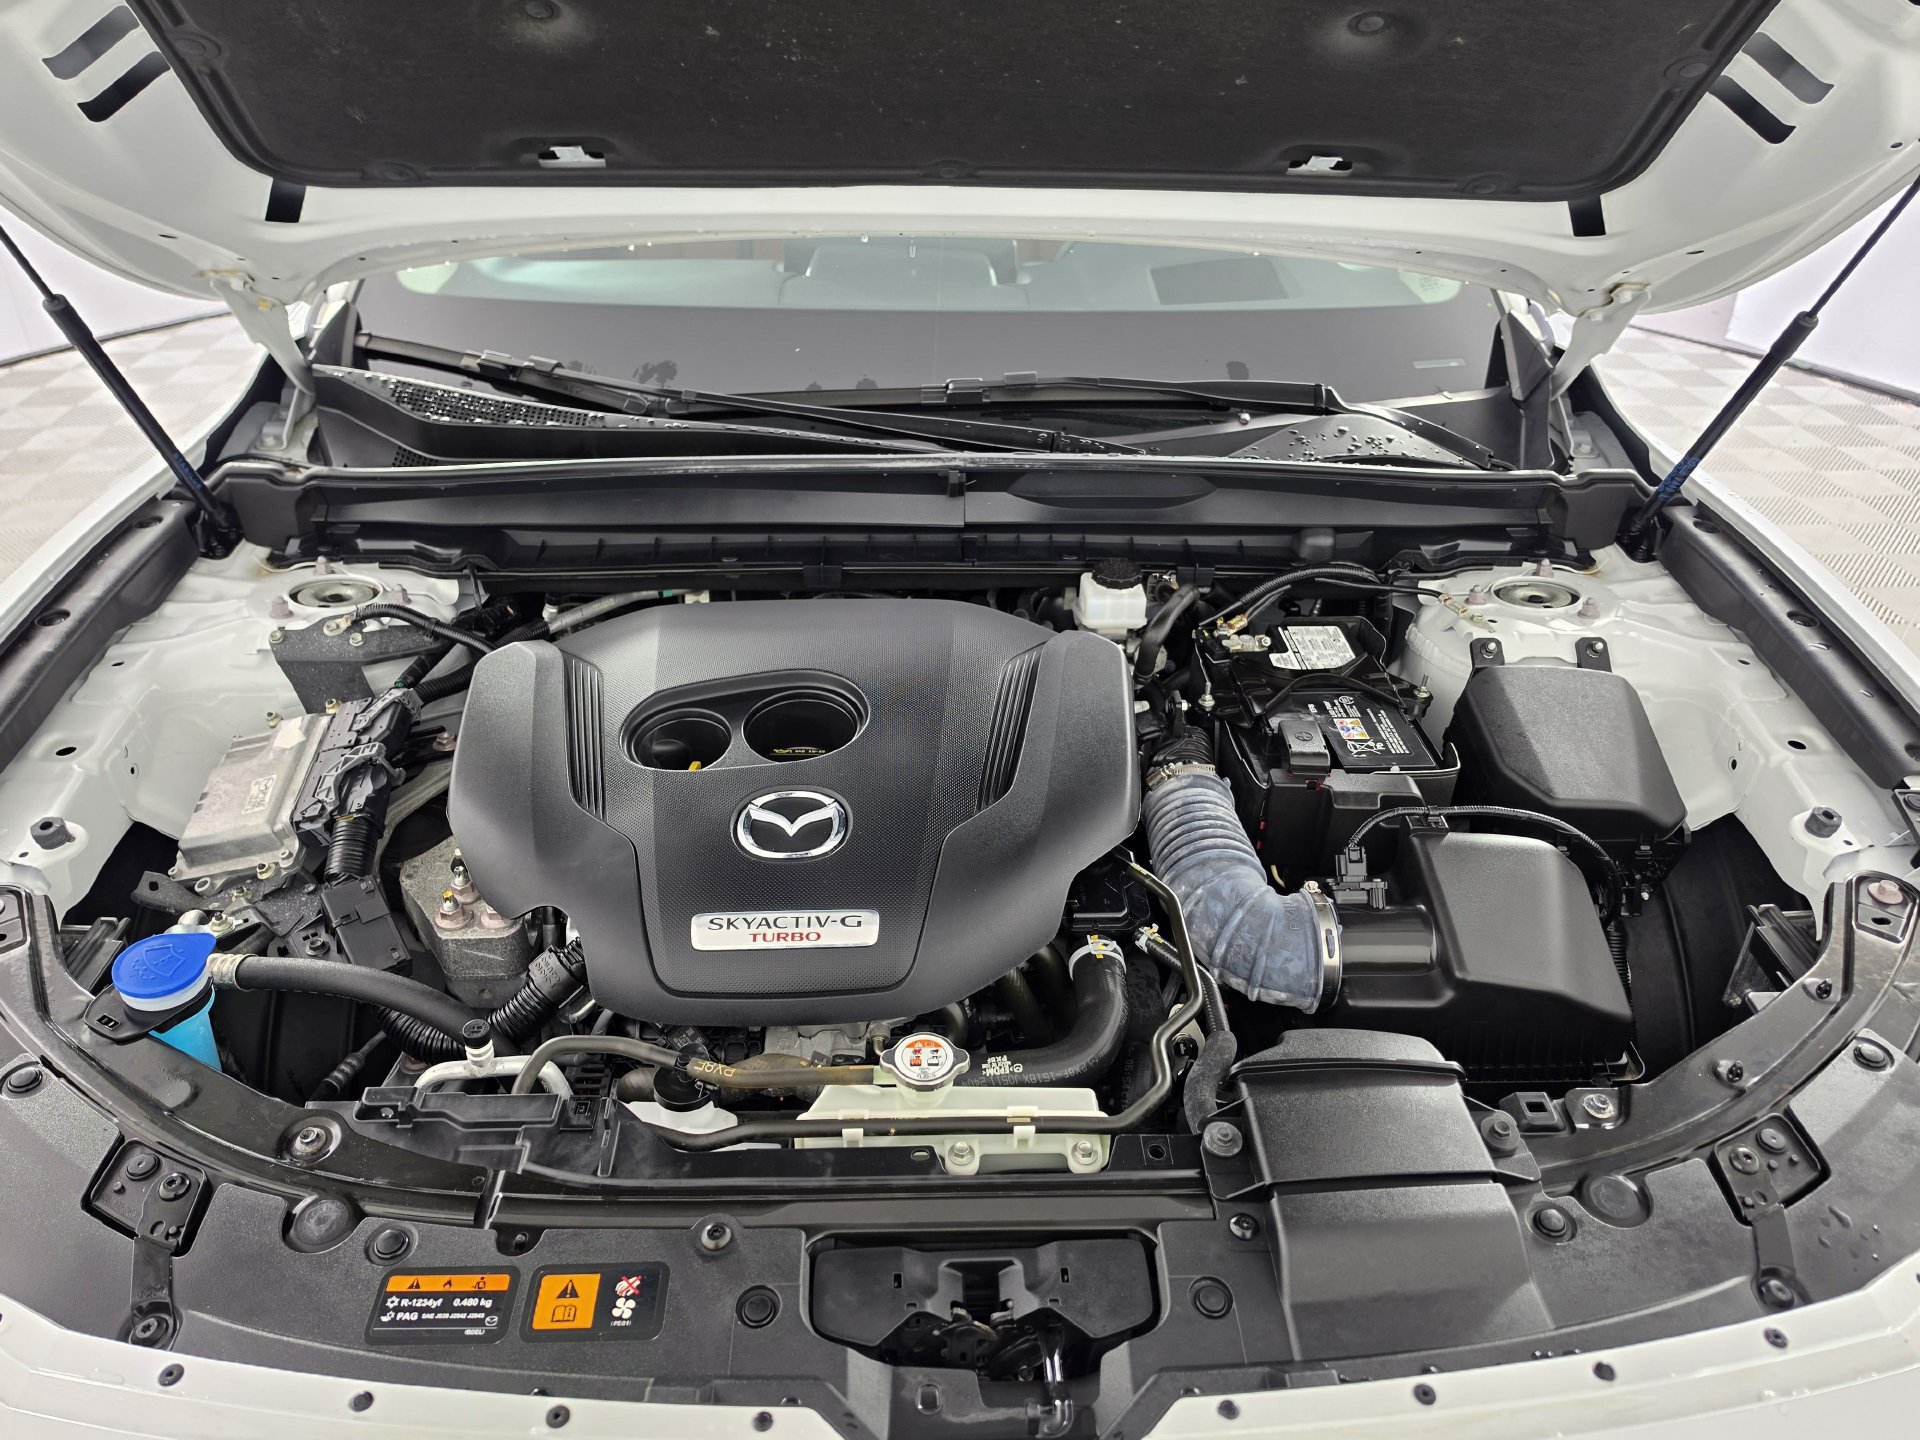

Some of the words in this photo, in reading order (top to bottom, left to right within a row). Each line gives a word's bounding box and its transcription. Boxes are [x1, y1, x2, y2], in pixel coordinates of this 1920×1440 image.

[707, 915, 863, 931] SKYACTIV-G
[748, 931, 822, 943] TURBO
[399, 1298, 444, 1309] R-1234yf
[452, 1297, 479, 1307] 0.480
[479, 1297, 493, 1309] kg
[395, 1311, 419, 1321] PAG
